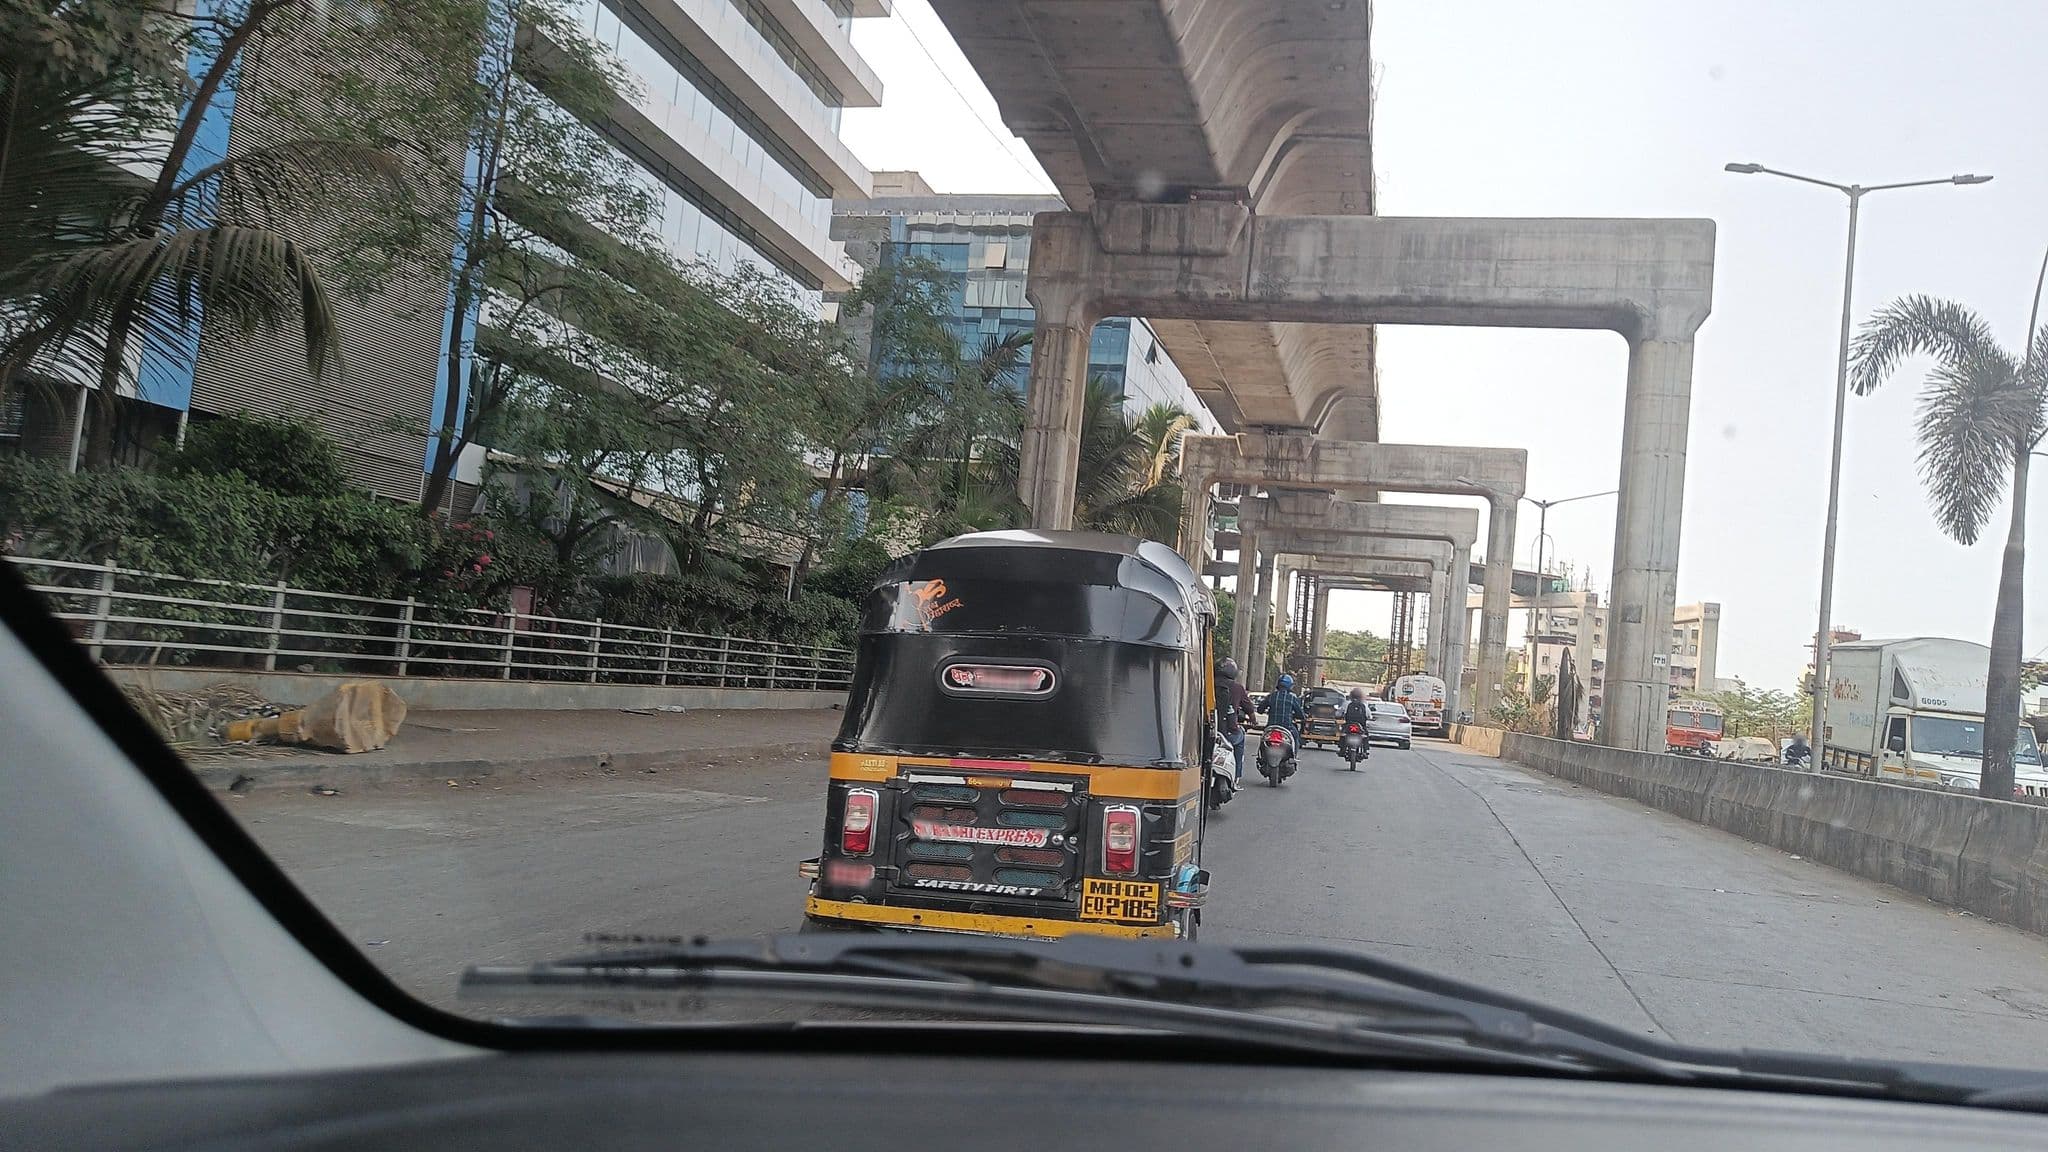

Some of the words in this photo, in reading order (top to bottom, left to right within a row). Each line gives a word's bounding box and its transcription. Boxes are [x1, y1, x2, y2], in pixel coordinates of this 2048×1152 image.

[1921, 697, 1948, 706] GOODS
[976, 827, 1044, 844] EXPRESS
[914, 879, 984, 891] SAFETY
[984, 884, 1042, 896] FIRST
[1090, 881, 1121, 896] MH
[1125, 884, 1153, 898] 02
[1106, 897, 1156, 918] 2185
